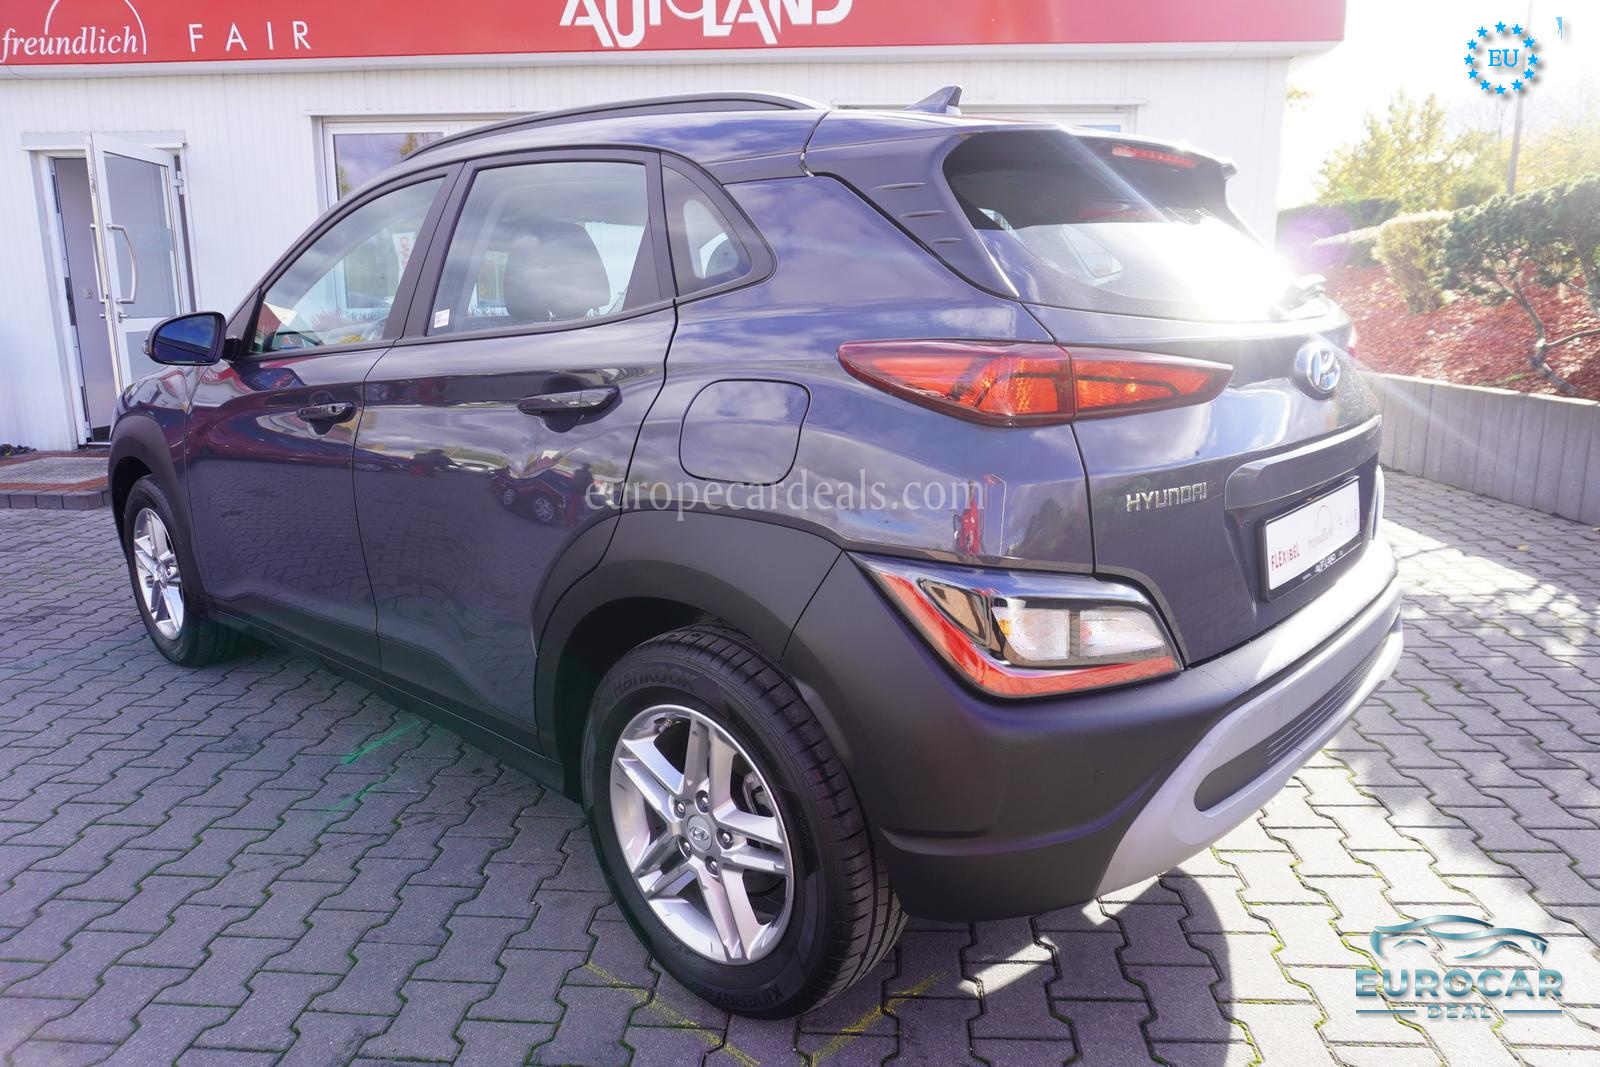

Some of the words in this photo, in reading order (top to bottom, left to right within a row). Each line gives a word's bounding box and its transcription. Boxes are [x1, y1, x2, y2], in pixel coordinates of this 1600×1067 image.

[0, 26, 139, 64] freundlich
[189, 21, 312, 52] FAIR
[1126, 481, 1207, 512] HYUNDAI
[1271, 543, 1300, 571] FLEXIBEL
